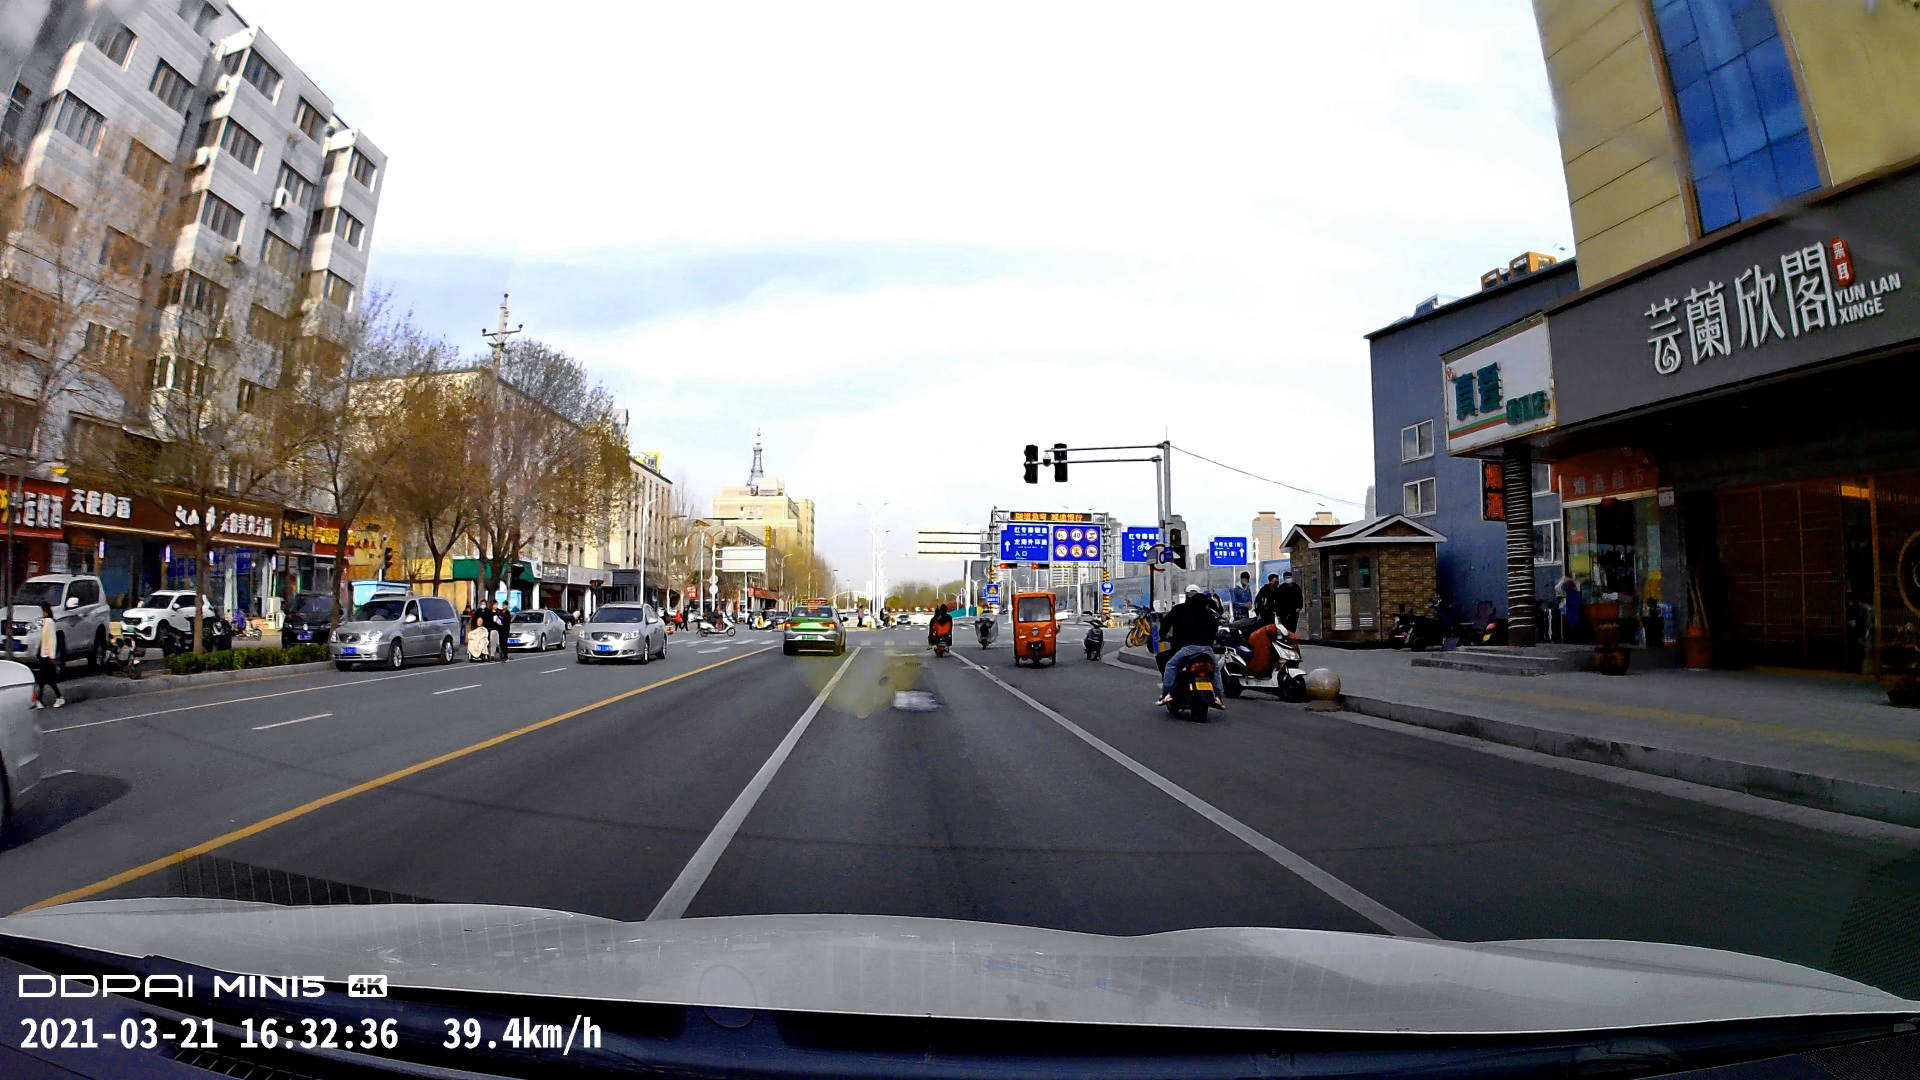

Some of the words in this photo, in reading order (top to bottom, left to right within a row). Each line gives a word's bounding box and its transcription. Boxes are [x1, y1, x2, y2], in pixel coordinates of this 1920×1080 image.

[1835, 283, 1866, 306] YUN
[1871, 272, 1901, 296] LAN
[1837, 297, 1885, 324] XINGE
